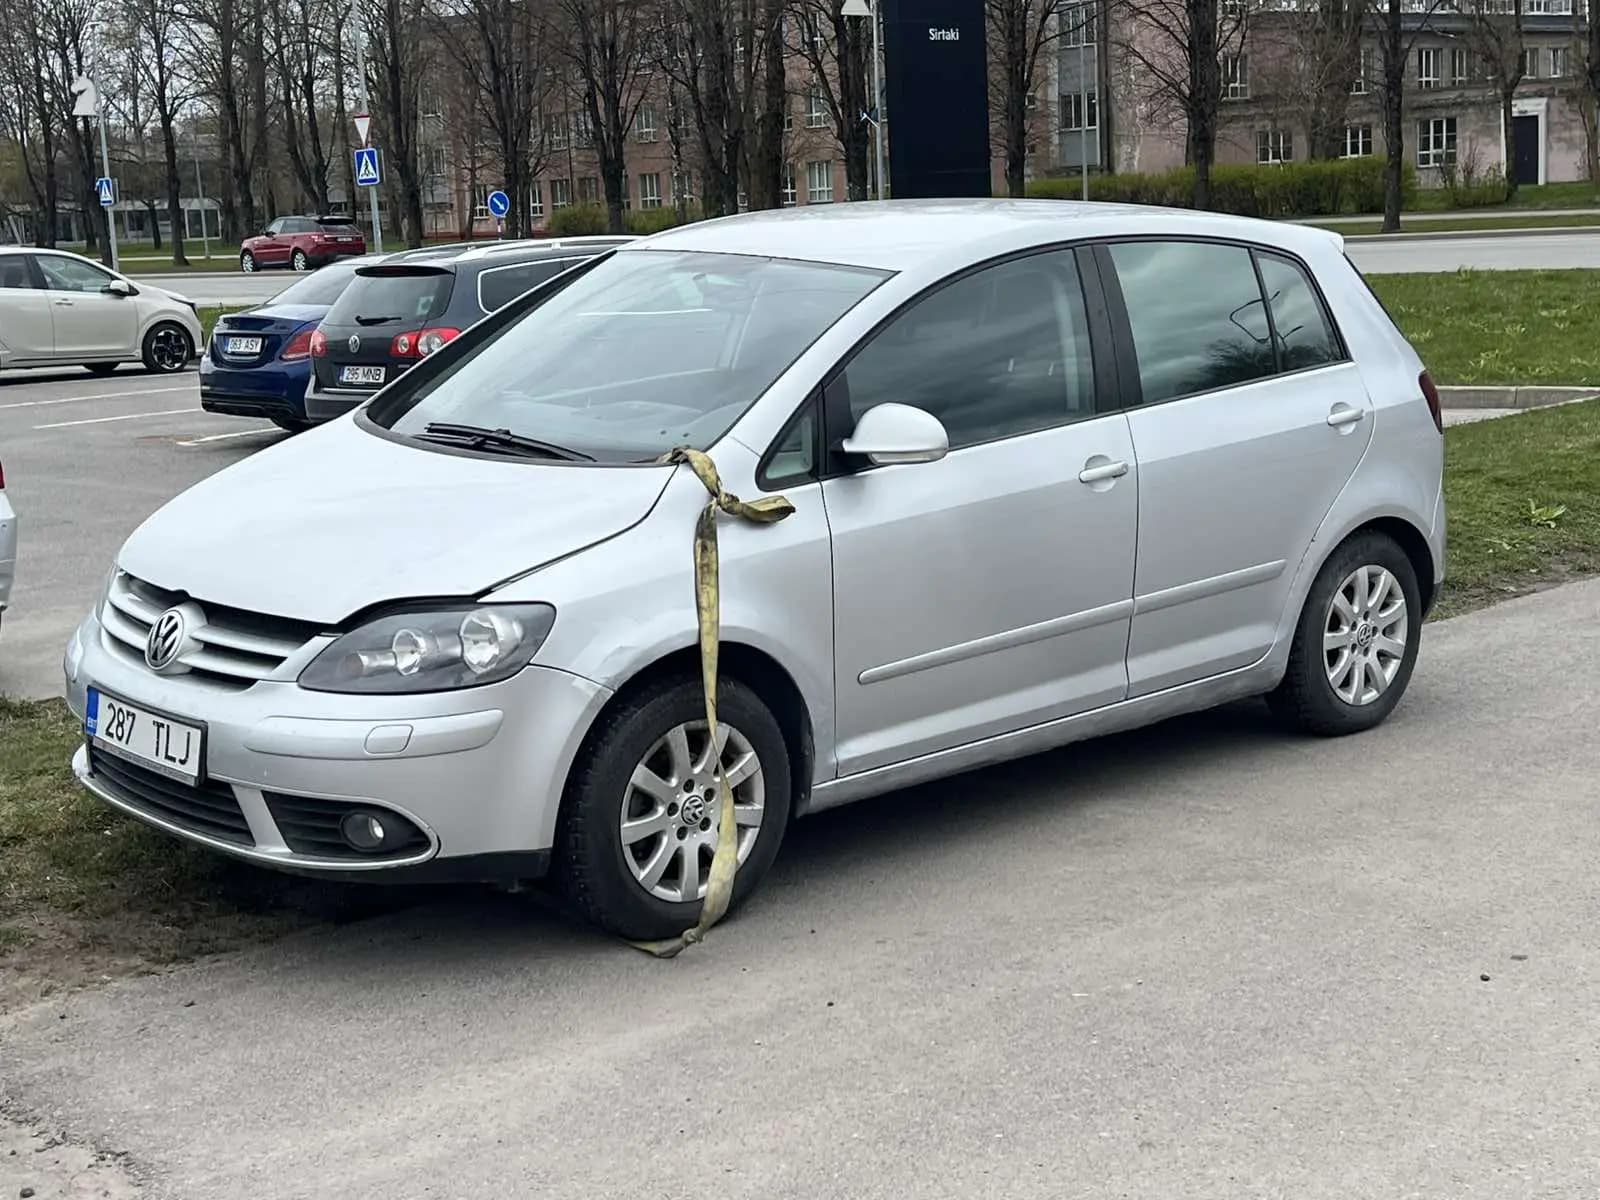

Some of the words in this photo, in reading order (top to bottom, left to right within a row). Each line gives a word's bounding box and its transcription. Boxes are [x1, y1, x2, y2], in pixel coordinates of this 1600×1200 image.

[929, 28, 959, 40] Sirtaki
[244, 338, 260, 350] ASY
[345, 367, 360, 380] 295
[361, 367, 382, 381] MNB
[105, 702, 136, 745] 287
[153, 720, 190, 765] TLJ
